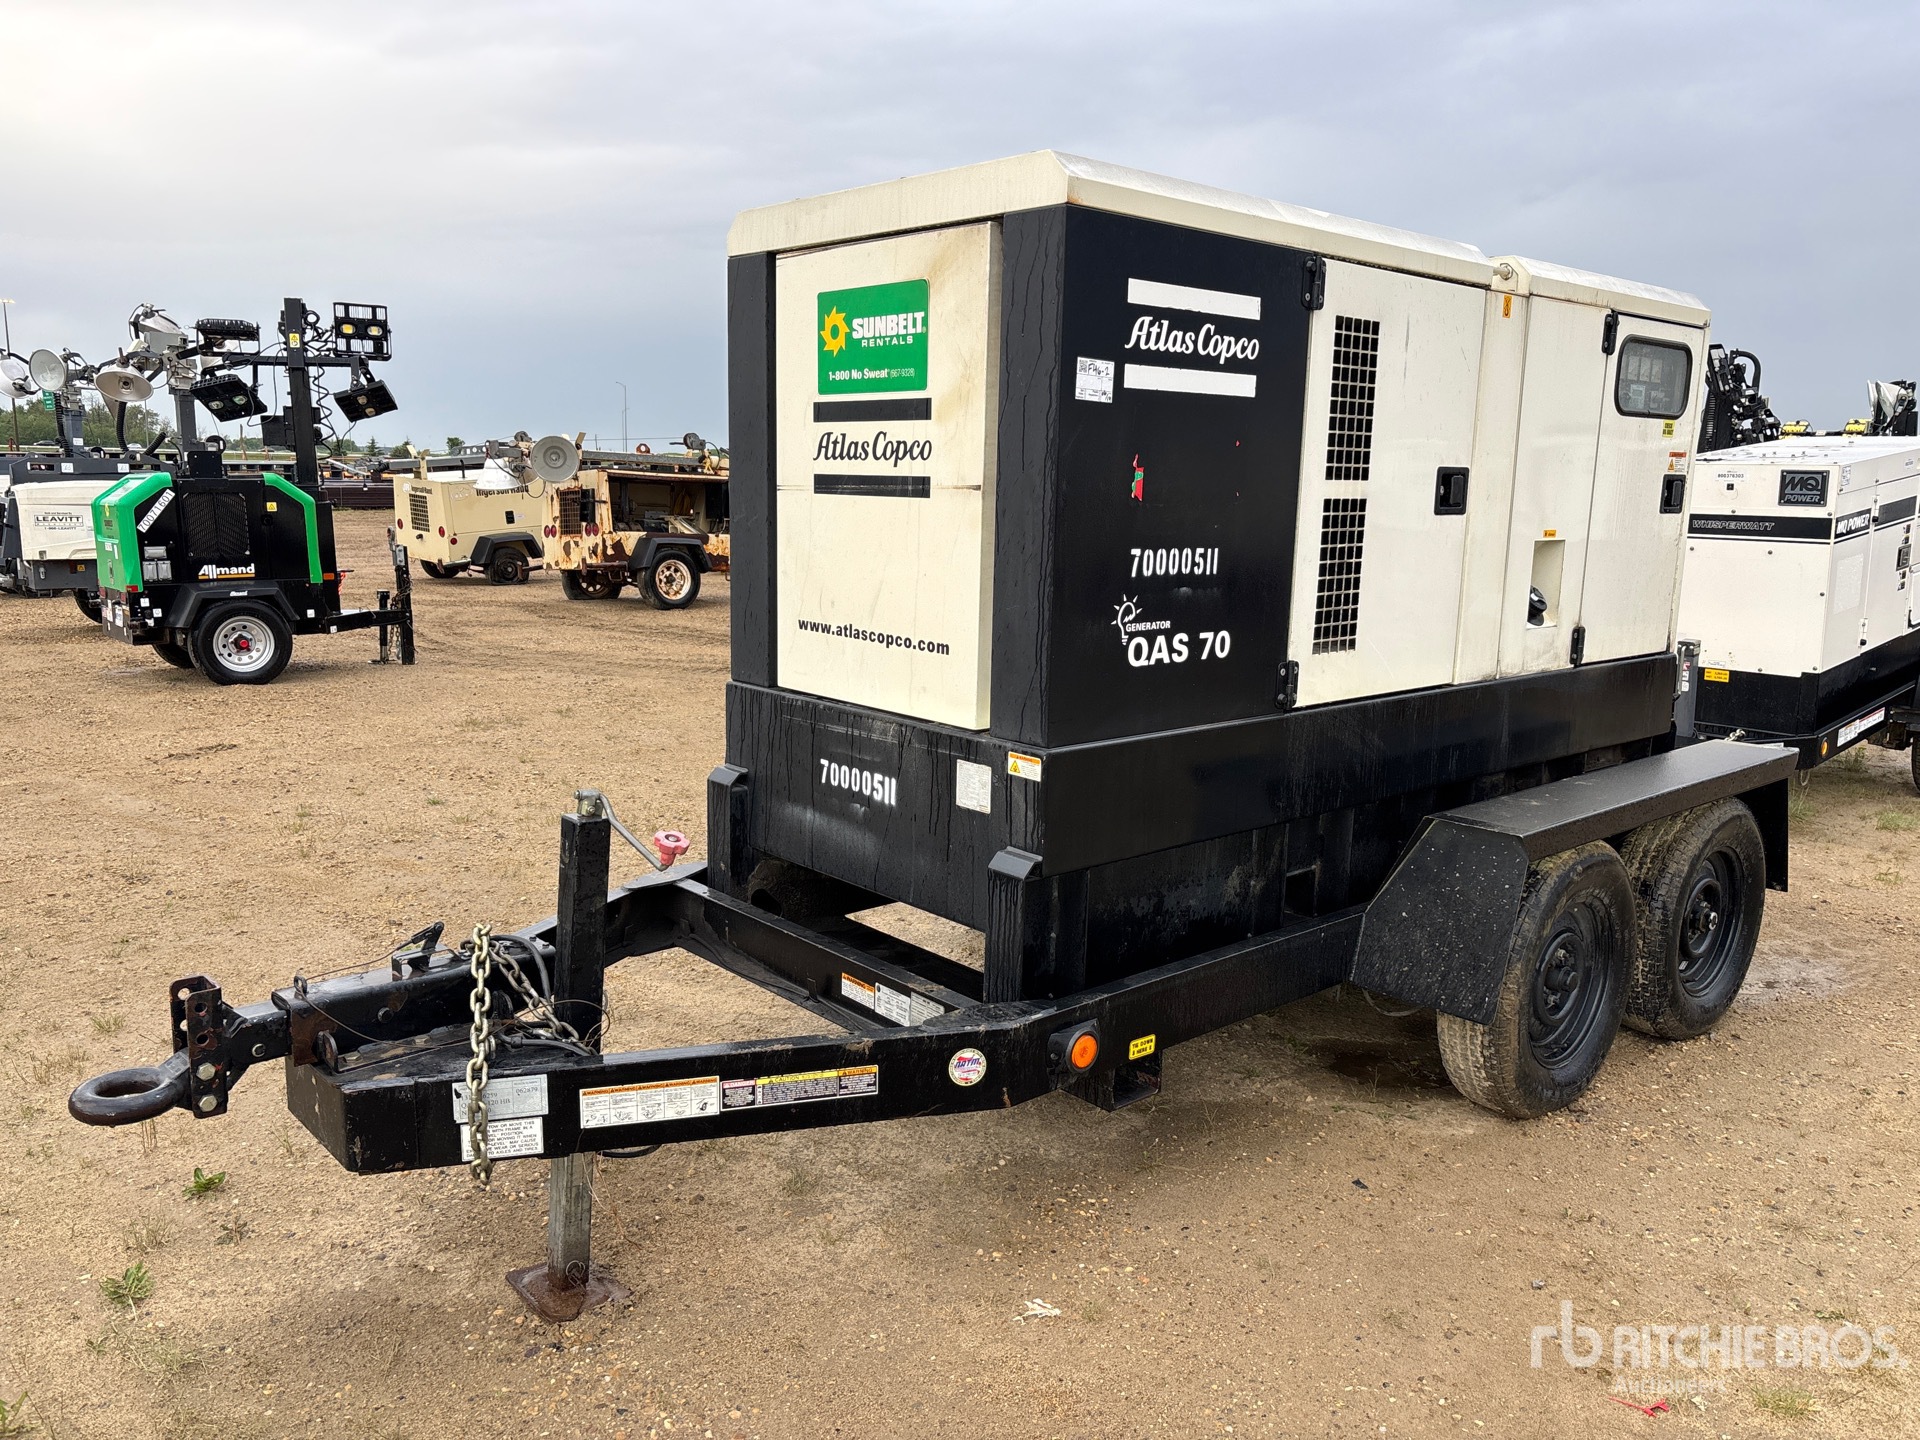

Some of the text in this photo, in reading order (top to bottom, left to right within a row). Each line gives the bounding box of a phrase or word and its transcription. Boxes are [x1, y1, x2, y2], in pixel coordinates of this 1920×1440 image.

[852, 311, 925, 339] SUNBELT
[861, 335, 914, 348] RENTALS
[1124, 316, 1260, 365] Atlas Copco
[828, 368, 915, 381] 1-800 No Sweat (667-9328)
[812, 430, 933, 468] Atlas Copco
[1784, 474, 1821, 494] MQ
[138, 491, 174, 531] 70071601
[1784, 494, 1820, 503] POWER
[1692, 520, 1775, 531] WHISPERWATT
[1836, 513, 1870, 535] MQ POWER
[198, 563, 256, 579] Allmand
[1130, 547, 1219, 578] 70000511
[798, 619, 950, 656] www.atlascopco.com
[1125, 620, 1171, 632] GENERATOR
[1127, 630, 1231, 668] QAS 70
[820, 758, 897, 807] 70000511
